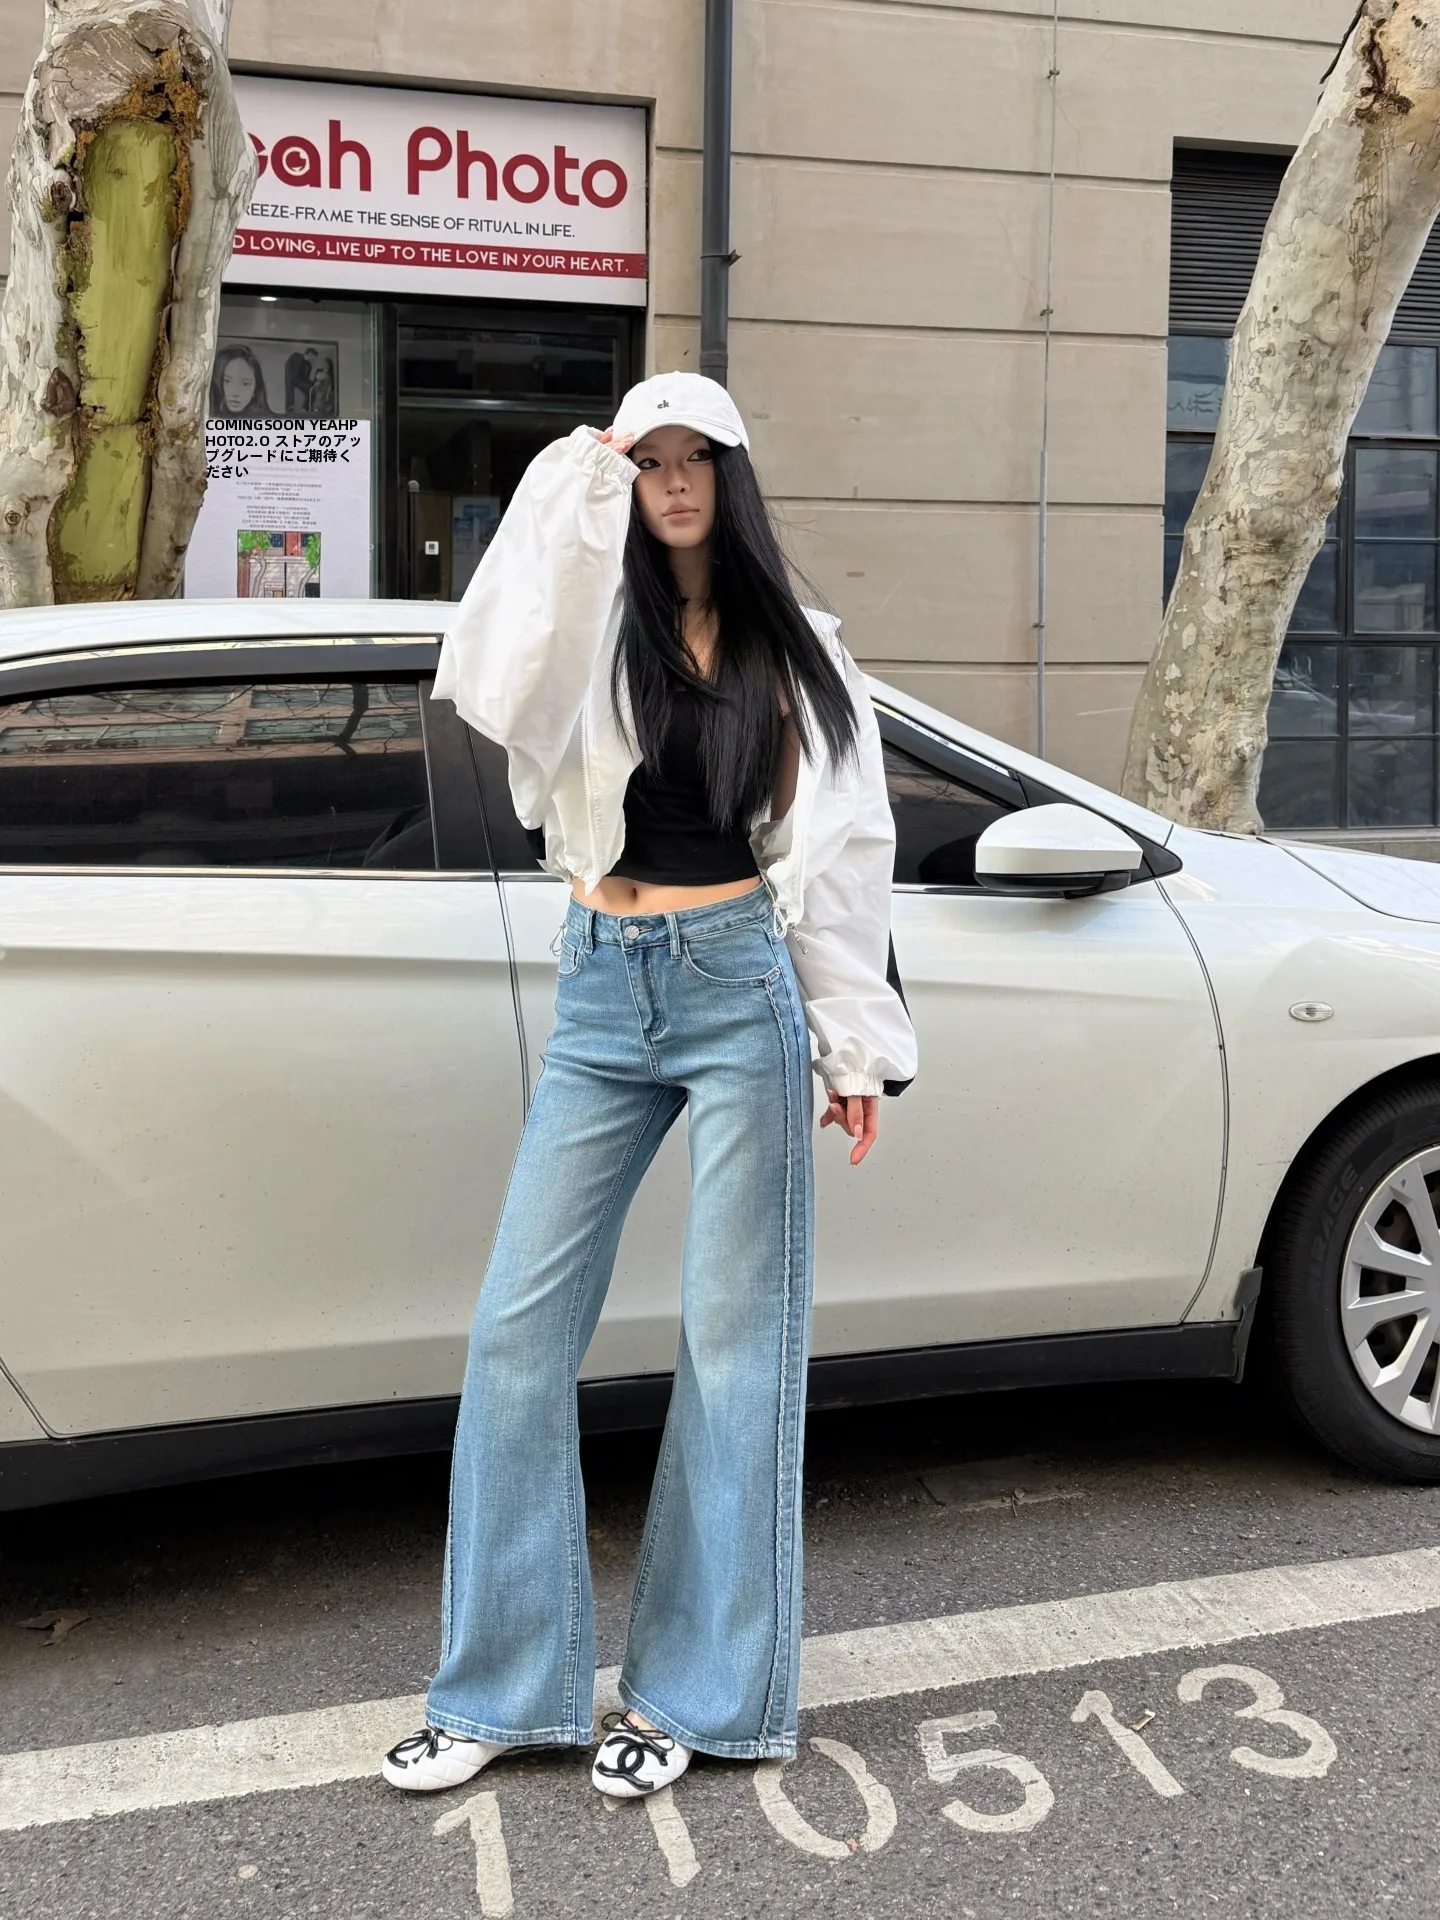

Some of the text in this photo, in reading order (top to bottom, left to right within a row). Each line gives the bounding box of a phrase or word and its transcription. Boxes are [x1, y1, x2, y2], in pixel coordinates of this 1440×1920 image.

[407, 126, 628, 208] Photo
[357, 210, 387, 225] THE
[390, 213, 440, 230] SENSE
[443, 217, 465, 231] OF
[468, 218, 523, 235] RITUAL
[525, 222, 540, 236] IN
[542, 223, 576, 238] LIFE.
[250, 235, 321, 256] LOVING,
[325, 241, 361, 256] LIVE
[364, 244, 386, 258] UP
[390, 245, 416, 260] TO
[420, 247, 452, 263] THE
[456, 248, 499, 265] LOVE
[502, 252, 518, 267] IN
[522, 253, 566, 269] YOUR
[570, 256, 629, 273] HEART.
